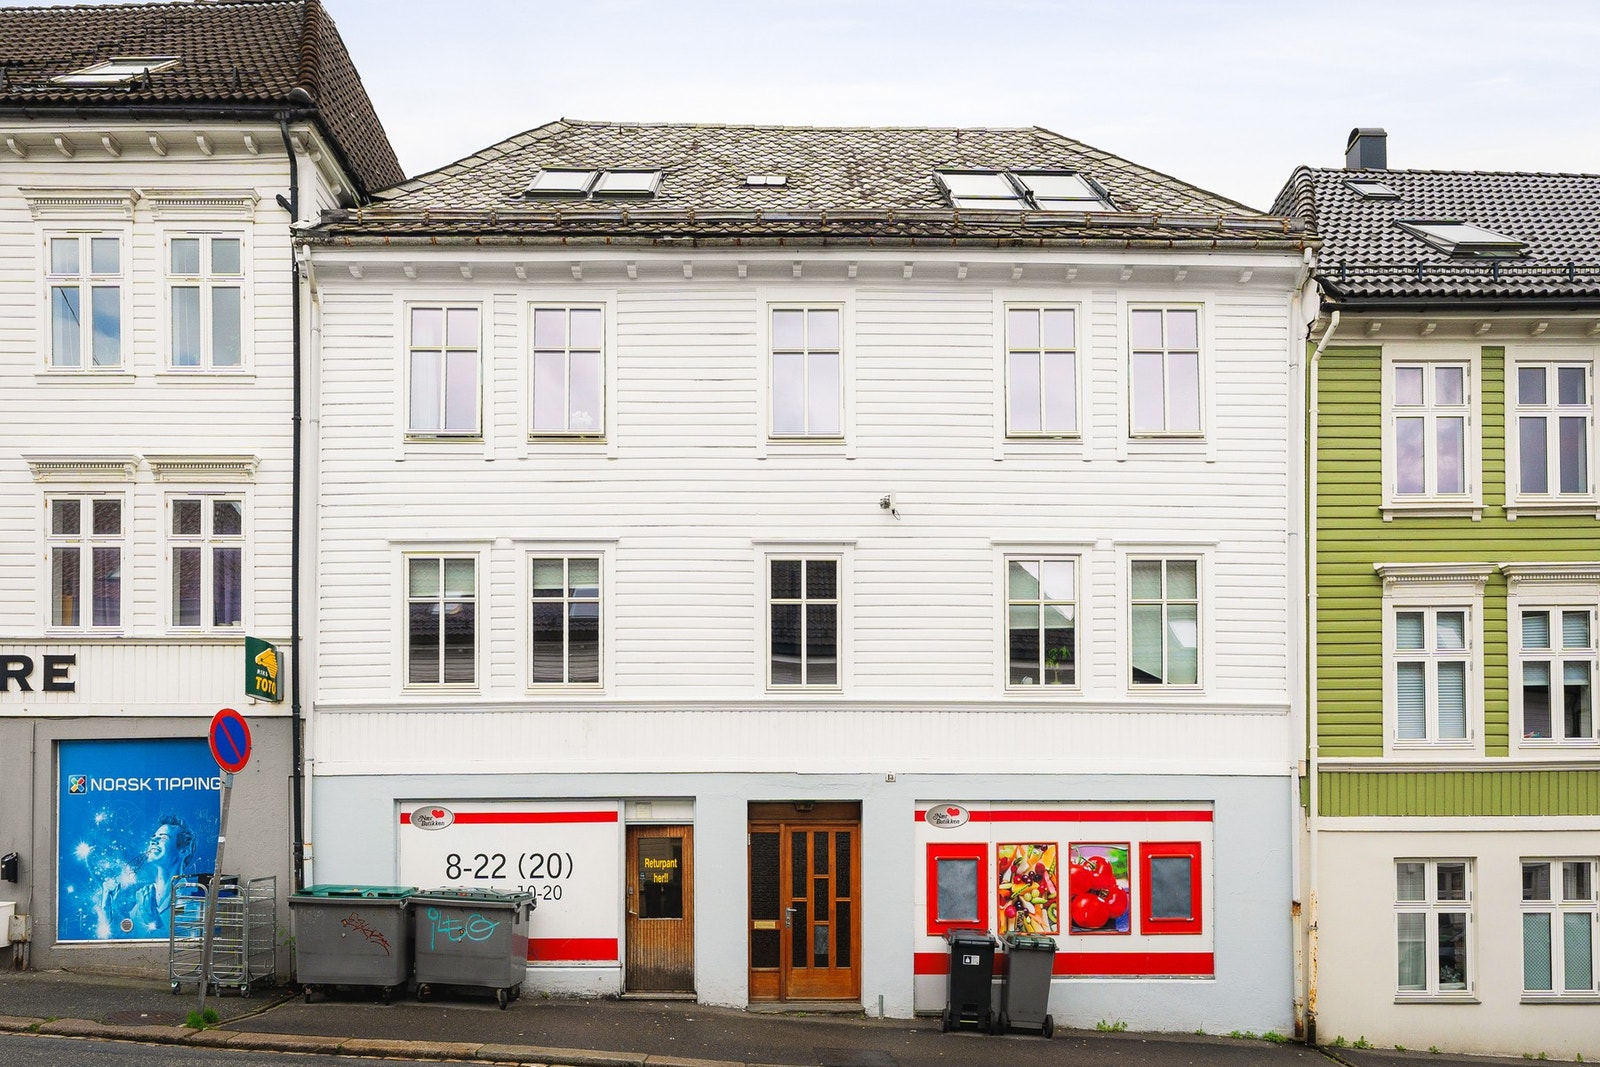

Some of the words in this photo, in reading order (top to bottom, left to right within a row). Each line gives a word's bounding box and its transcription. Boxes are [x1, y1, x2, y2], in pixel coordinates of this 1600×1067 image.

[0, 654, 76, 692] RE
[256, 676, 276, 695] TOTO
[90, 778, 152, 791] NORSK
[154, 777, 221, 790] TIPPING
[446, 853, 507, 880] 8-22
[518, 852, 573, 880] (20)
[644, 858, 678, 870] Returpant
[653, 873, 669, 883] her!!
